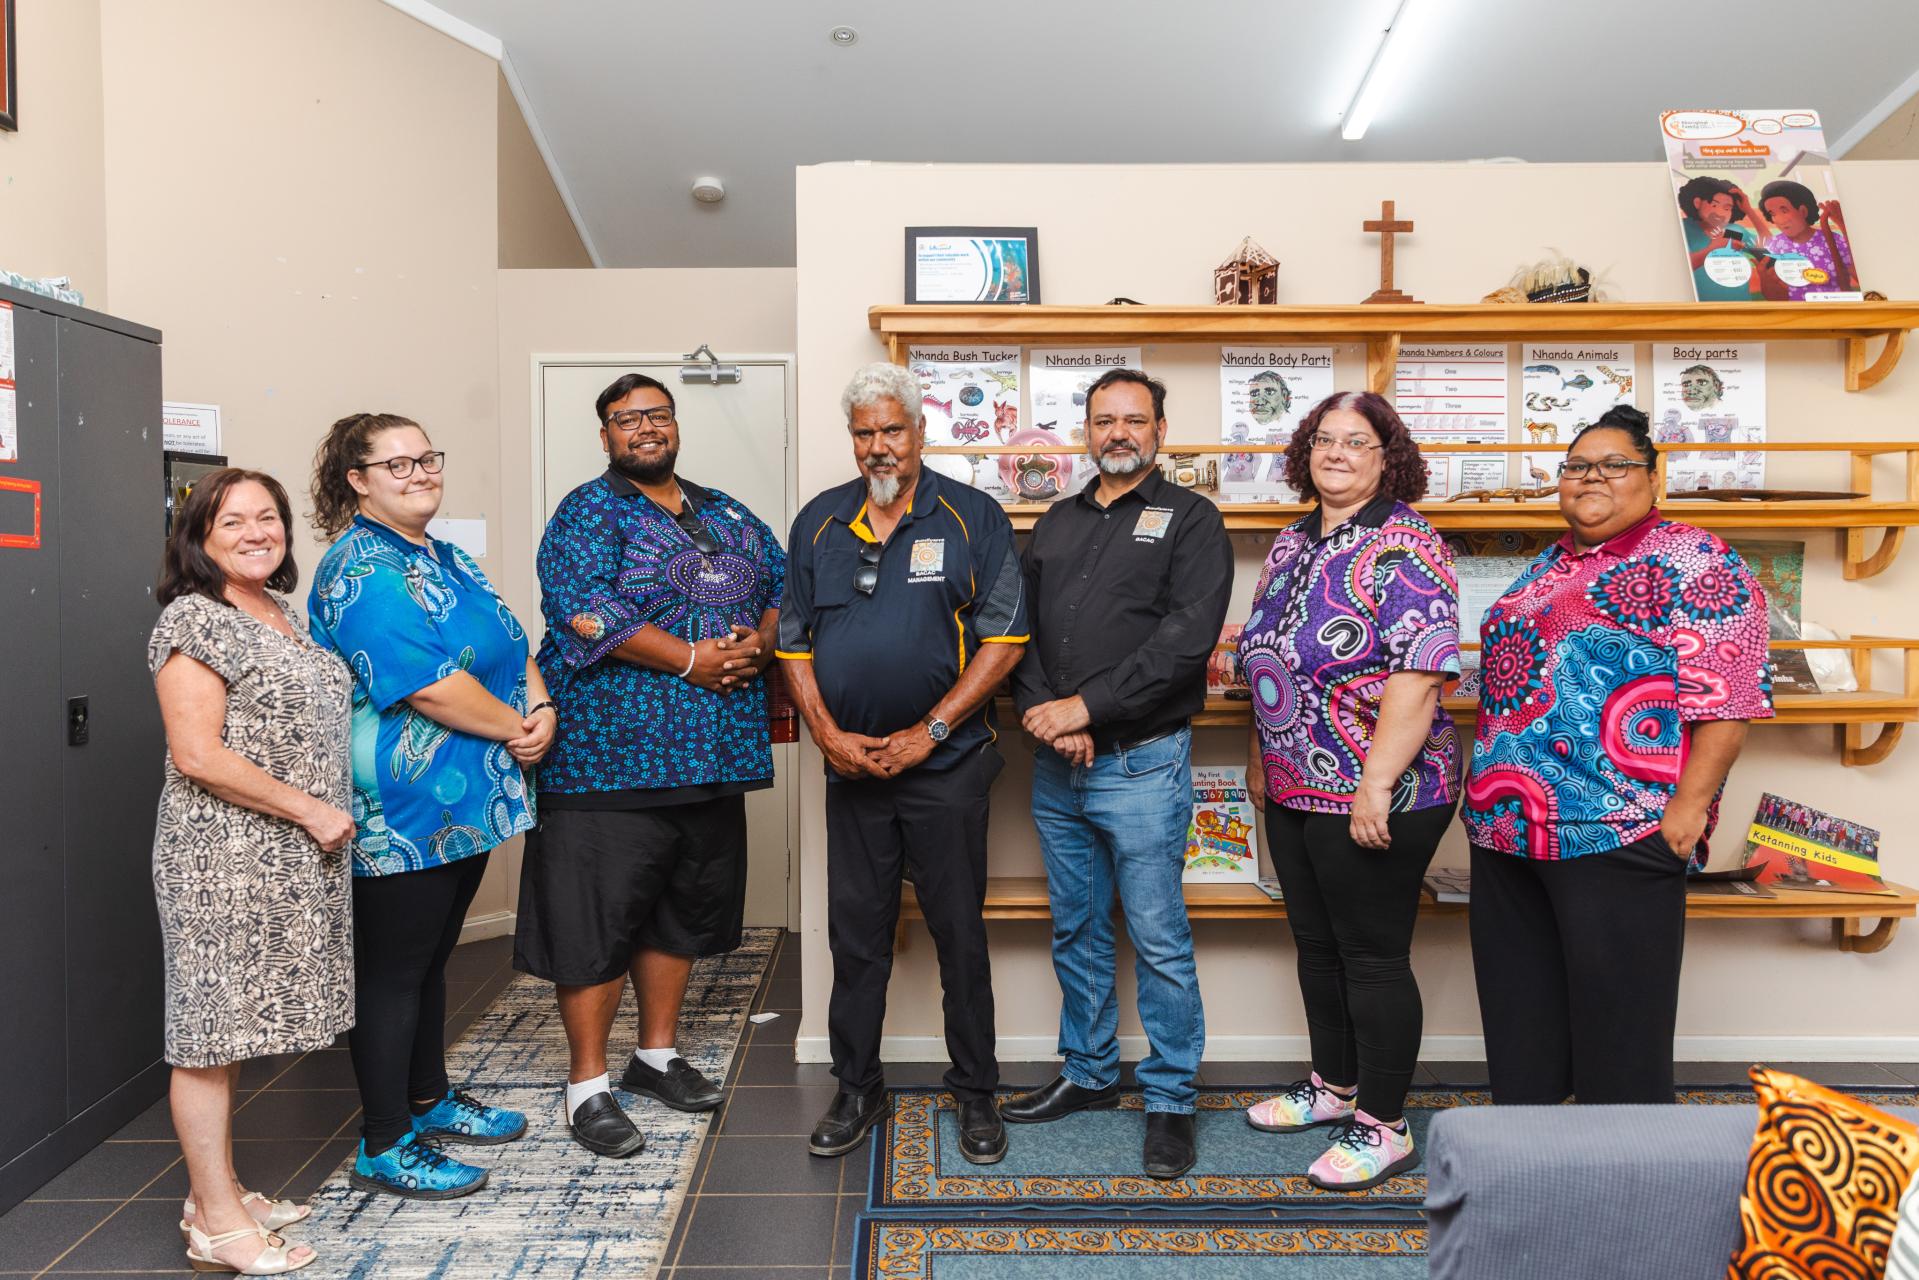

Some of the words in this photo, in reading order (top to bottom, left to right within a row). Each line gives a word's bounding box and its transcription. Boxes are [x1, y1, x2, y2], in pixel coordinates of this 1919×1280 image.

[910, 351, 949, 360] Nhanda
[953, 351, 977, 360] Bush
[982, 351, 1018, 361] Tucker
[1533, 350, 1573, 360] Nhanda
[1577, 350, 1618, 360] Animals
[1673, 347, 1701, 360] Body
[1706, 348, 1738, 360] parts
[1046, 354, 1090, 365] Nhanda
[1095, 354, 1126, 365] Birds
[1222, 353, 1264, 364] Nhanda
[1270, 353, 1297, 368] Body
[1302, 354, 1330, 366] Parts
[1192, 780, 1215, 788] unting
[1753, 830, 1807, 856] Katanning
[1814, 851, 1837, 864] Kids
